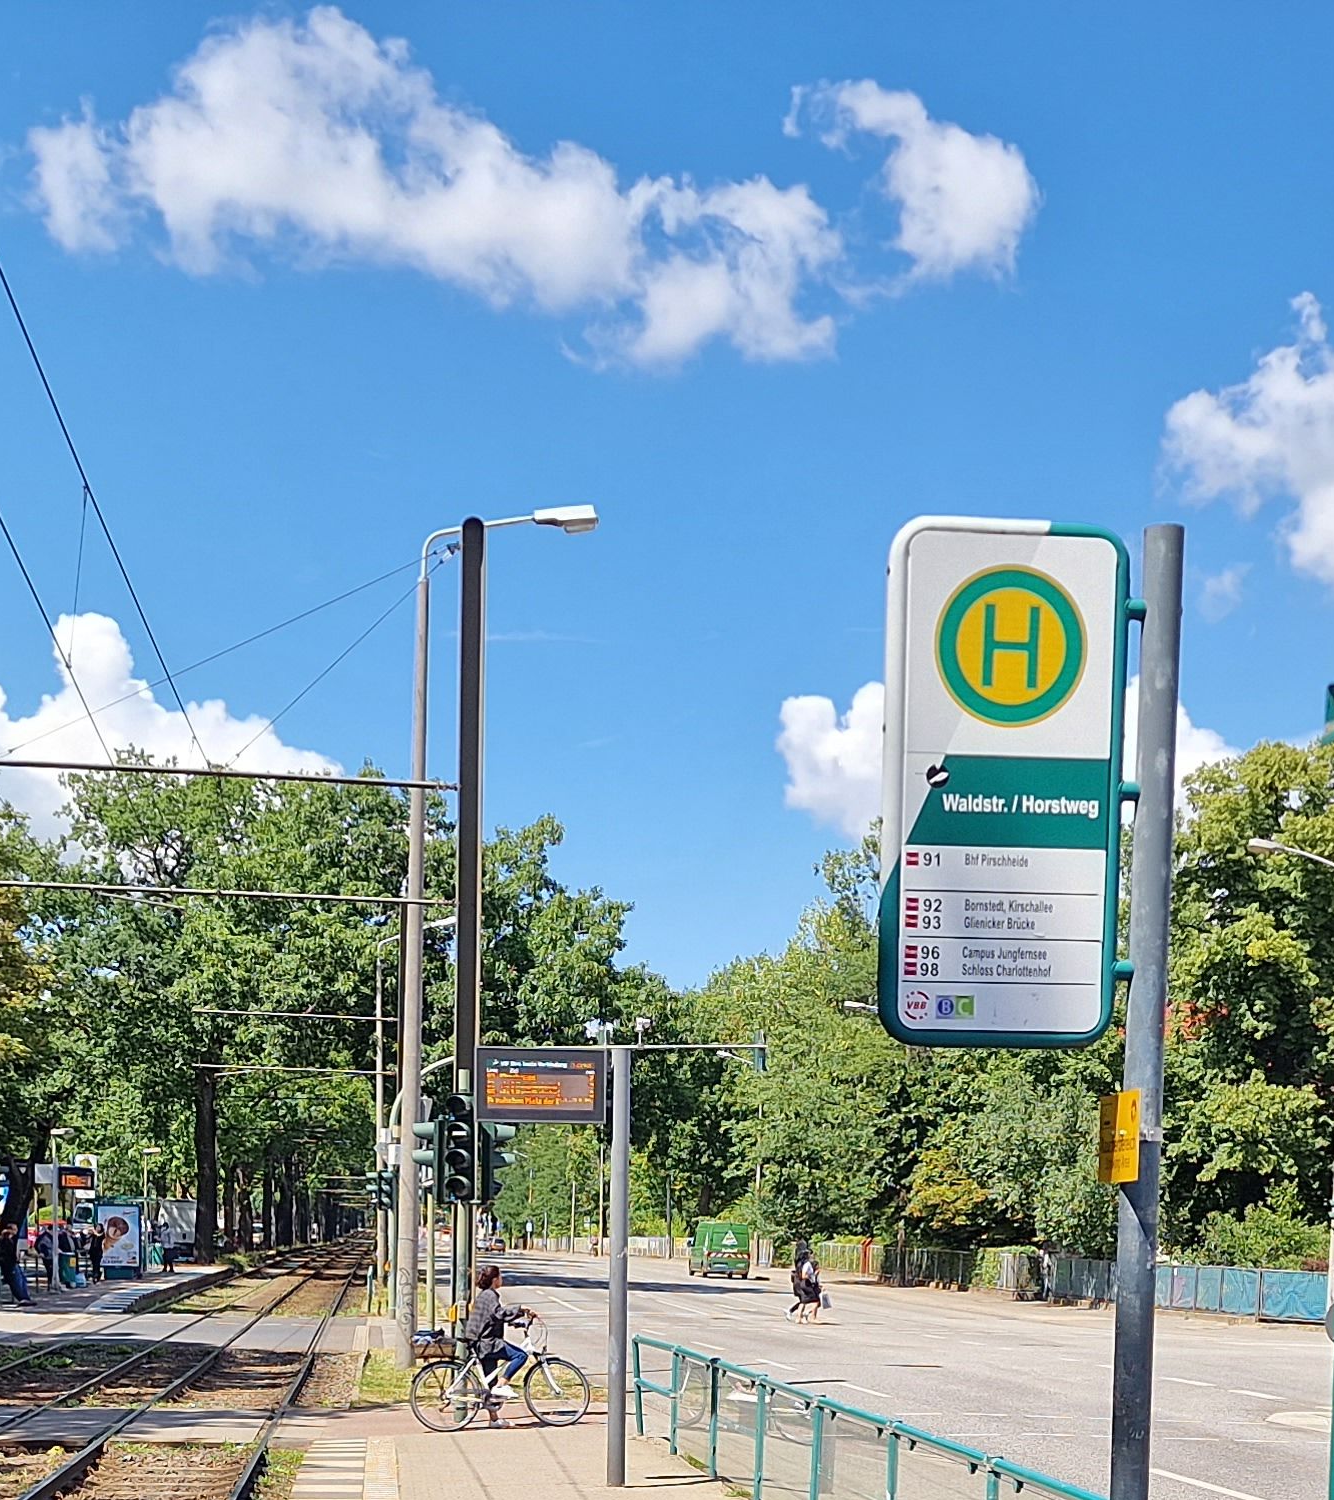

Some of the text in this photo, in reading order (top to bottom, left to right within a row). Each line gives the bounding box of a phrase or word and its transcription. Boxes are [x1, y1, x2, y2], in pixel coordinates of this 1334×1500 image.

[982, 603, 1040, 689] H
[942, 793, 1099, 819] Waldstr. / Horstweg
[923, 852, 940, 867] 91
[964, 853, 979, 866] Bhf
[981, 854, 1029, 868] Pirschheide
[923, 898, 942, 912] 92
[964, 898, 1006, 914] Bornstedt,
[1008, 900, 1054, 913] Kirschallee
[922, 915, 941, 929] 93
[963, 916, 1005, 929] Glienicker
[1007, 916, 1036, 930] Brücke
[921, 945, 940, 959] 96
[962, 946, 995, 960] Campus
[997, 947, 1047, 962] Jungfernsee
[920, 963, 939, 976] 98
[961, 963, 994, 976] Schloss
[996, 964, 1052, 977] Charlottenhof
[906, 1001, 927, 1010] VBB
[941, 999, 970, 1016] B C
